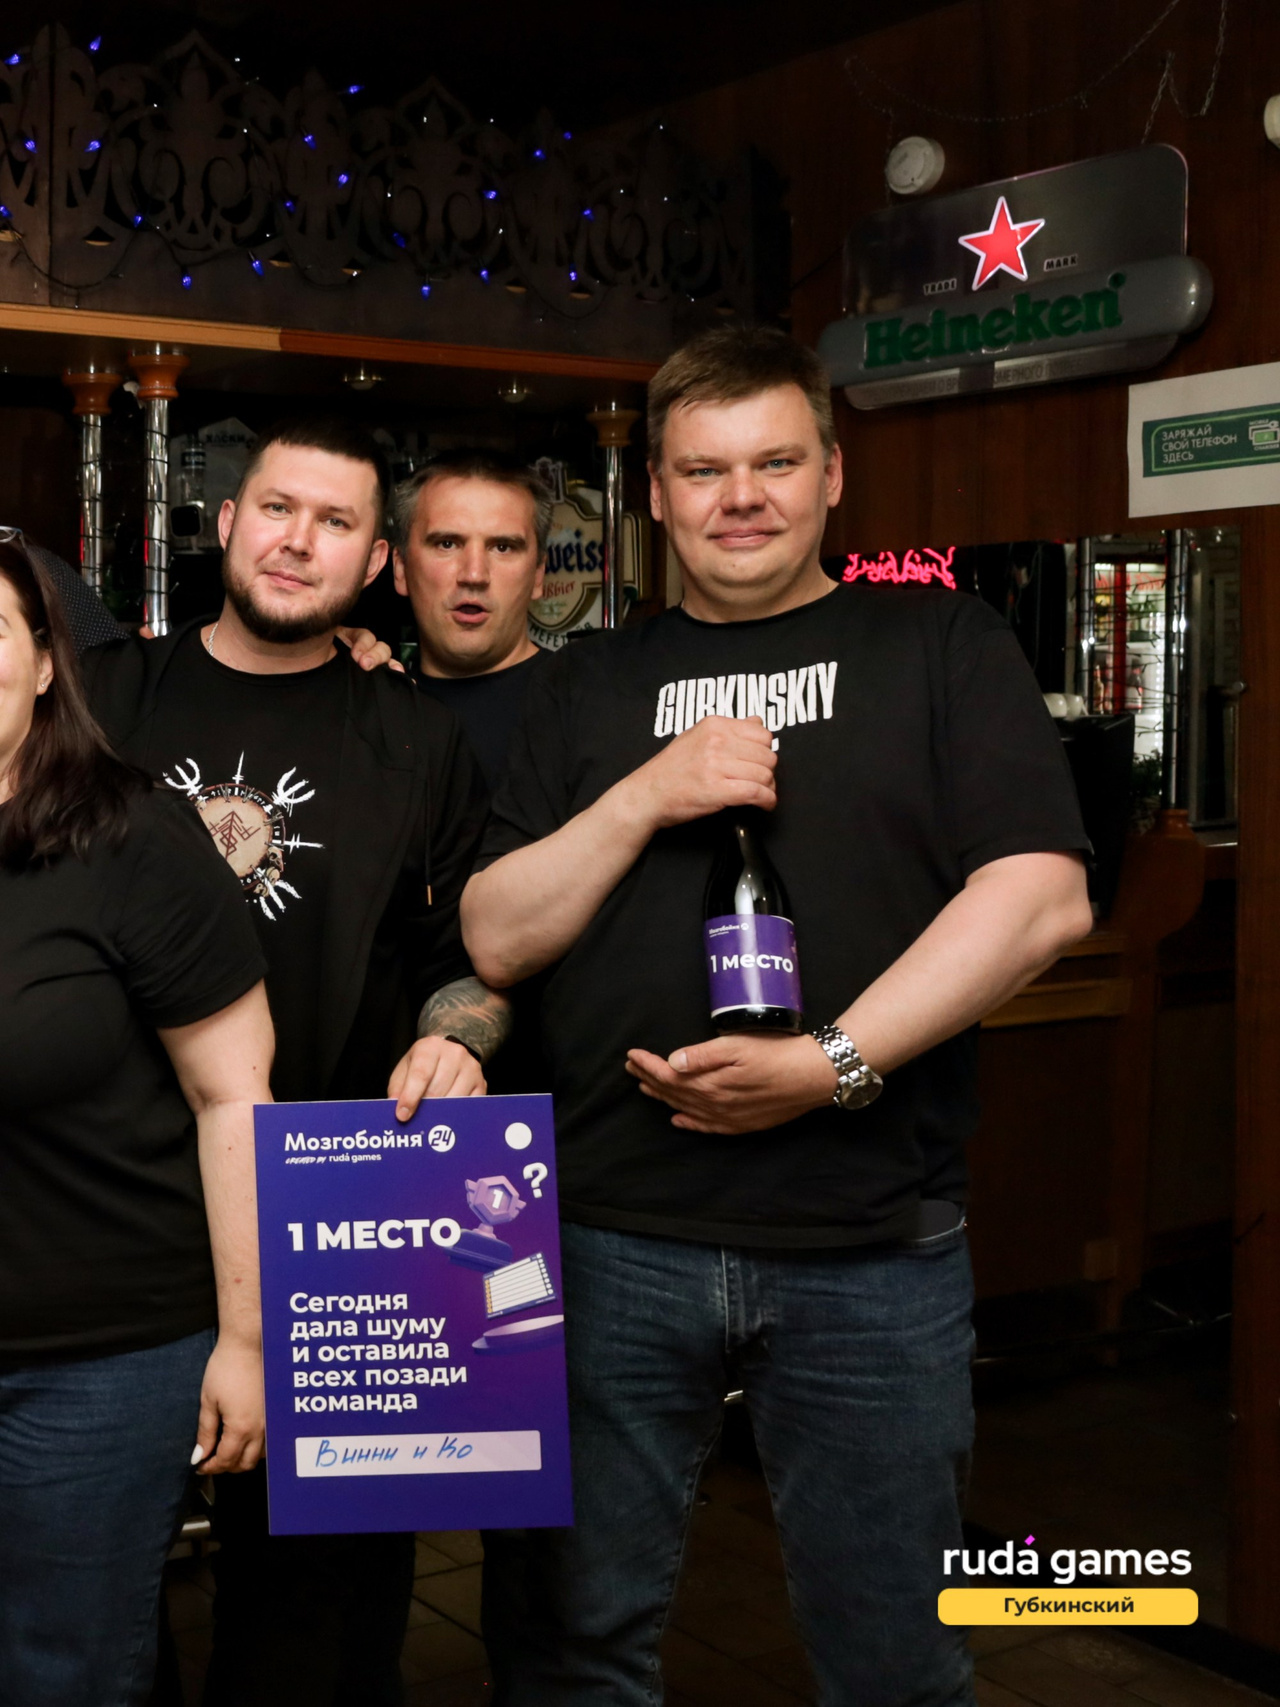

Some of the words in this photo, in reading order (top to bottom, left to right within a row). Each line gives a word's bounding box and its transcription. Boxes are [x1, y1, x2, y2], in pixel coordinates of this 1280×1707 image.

[1045, 256, 1077, 271] MARK
[924, 279, 957, 295] TRADE
[864, 287, 1124, 369] Heineken
[1162, 424, 1212, 441] ЗАРЯЖАЙ
[1162, 439, 1189, 452] СВОЙ
[1192, 434, 1237, 448] ТЕЛЕФОН
[1163, 451, 1194, 463] ЗДЕСЬ
[710, 954, 717, 973] 1
[285, 1129, 422, 1152] Мозгобойня
[430, 1128, 453, 1147] 24
[351, 1153, 382, 1164] games
[492, 1189, 504, 1209] 1
[287, 1223, 304, 1251] 1
[317, 1218, 461, 1250] МЕСТО
[290, 1292, 408, 1315] Сегодня
[291, 1319, 359, 1342] дала
[367, 1315, 446, 1339] шуму
[293, 1346, 310, 1363] и
[318, 1339, 450, 1362] оставила
[293, 1369, 358, 1388] всех
[366, 1363, 467, 1387] позади
[294, 1393, 418, 1414] команда
[315, 1439, 399, 1467] Винни
[413, 1446, 428, 1460] и
[437, 1435, 473, 1459] Ко
